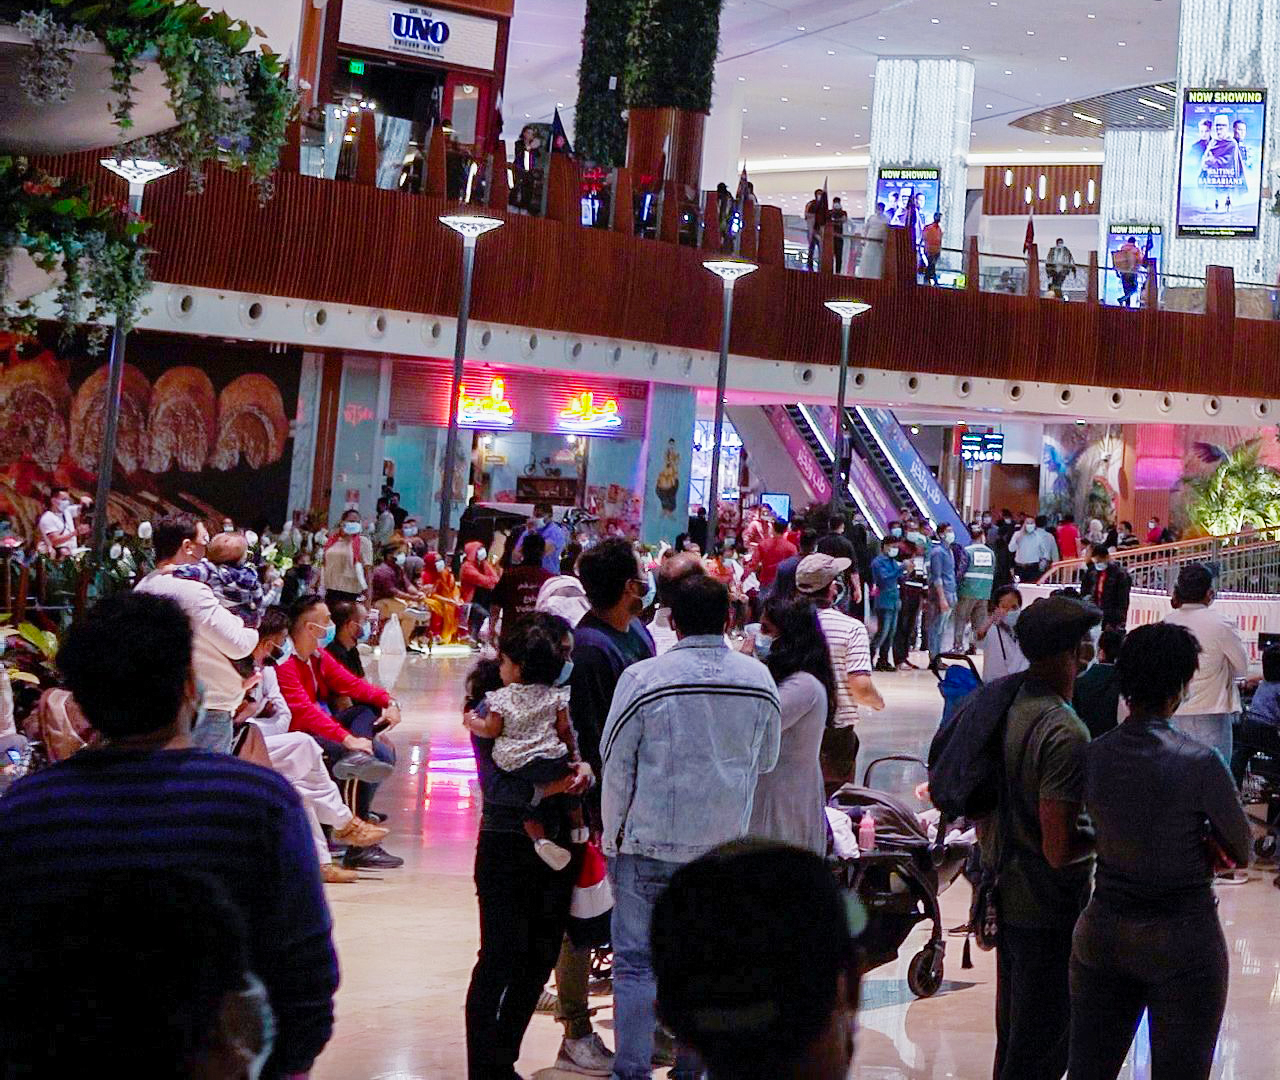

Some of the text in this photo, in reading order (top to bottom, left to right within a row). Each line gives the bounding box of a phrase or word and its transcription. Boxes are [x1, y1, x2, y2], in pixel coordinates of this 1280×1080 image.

[392, 12, 450, 44] UNO
[1189, 91, 1262, 103] NOW SHOWING
[881, 170, 938, 180] NOW SHOWING
